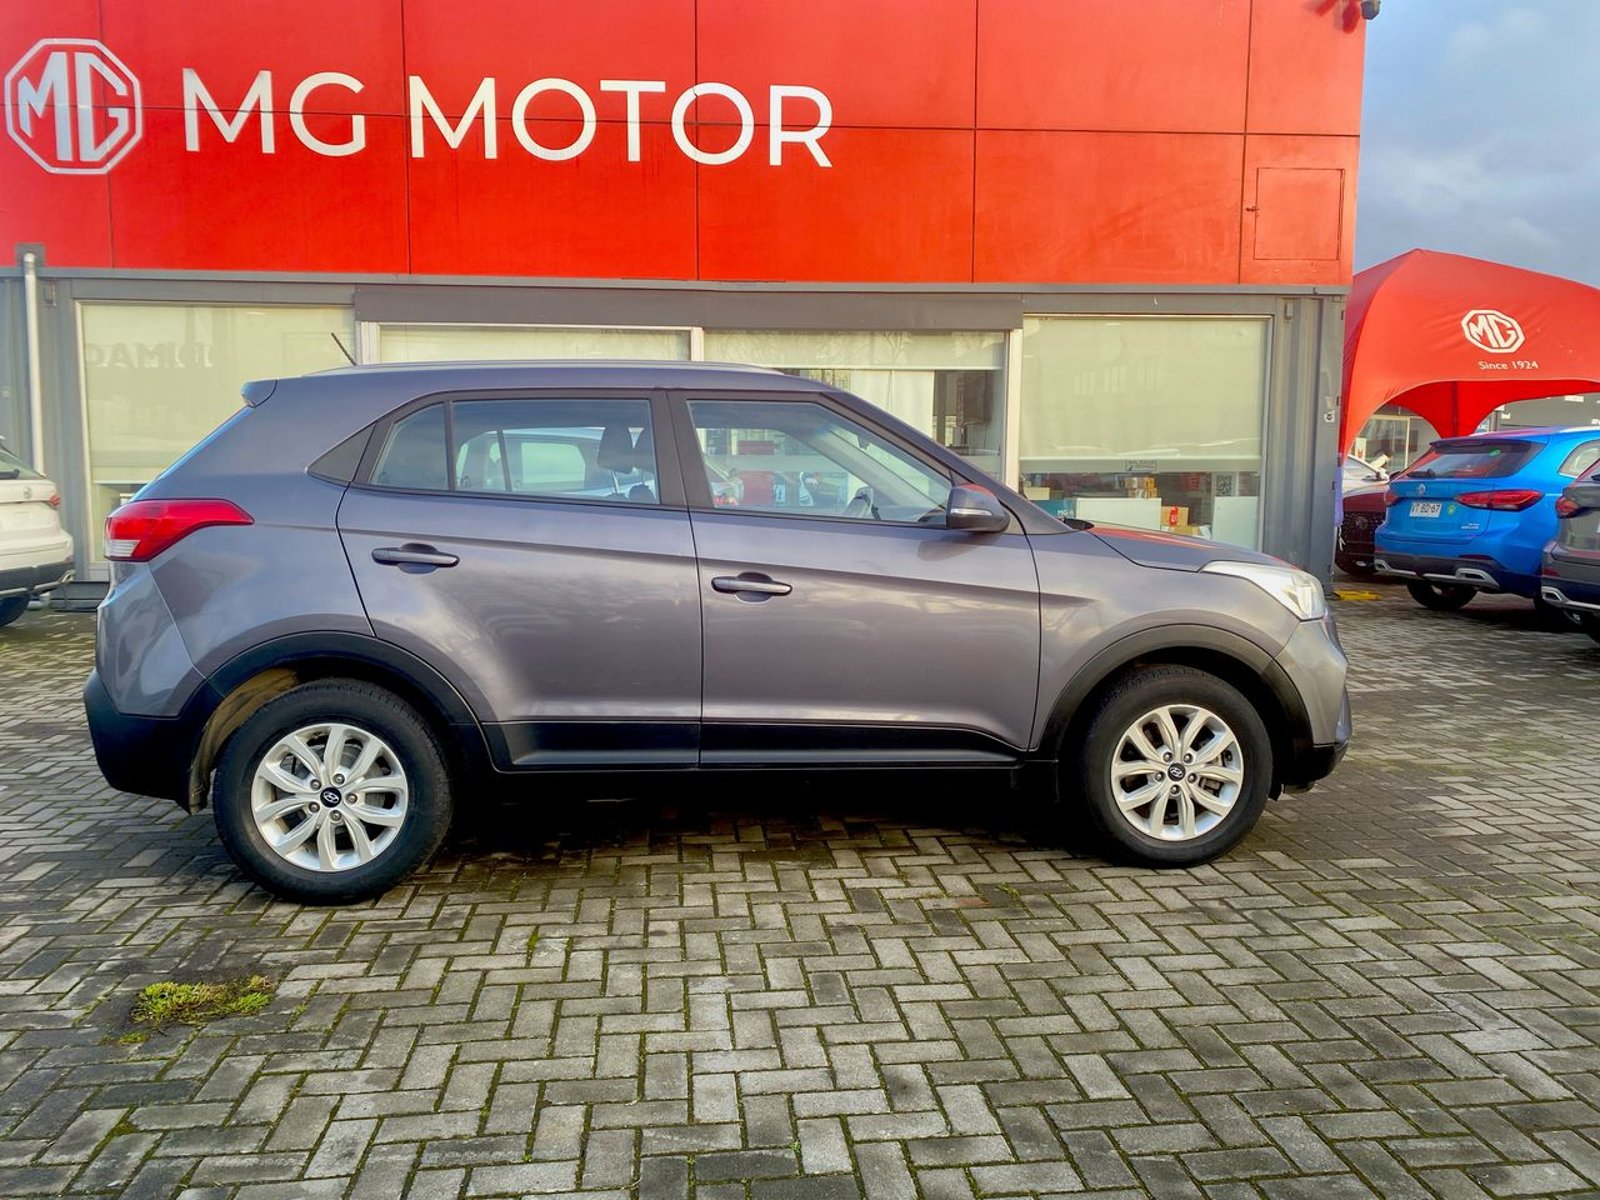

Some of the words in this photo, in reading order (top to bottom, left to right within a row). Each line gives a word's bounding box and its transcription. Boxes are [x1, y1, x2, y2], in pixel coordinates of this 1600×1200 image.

[17, 51, 129, 162] MG
[183, 69, 366, 157] MG
[408, 76, 833, 168] MOTOR
[1468, 315, 1517, 348] MG
[1478, 361, 1508, 370] Since
[1512, 360, 1539, 370] 1924
